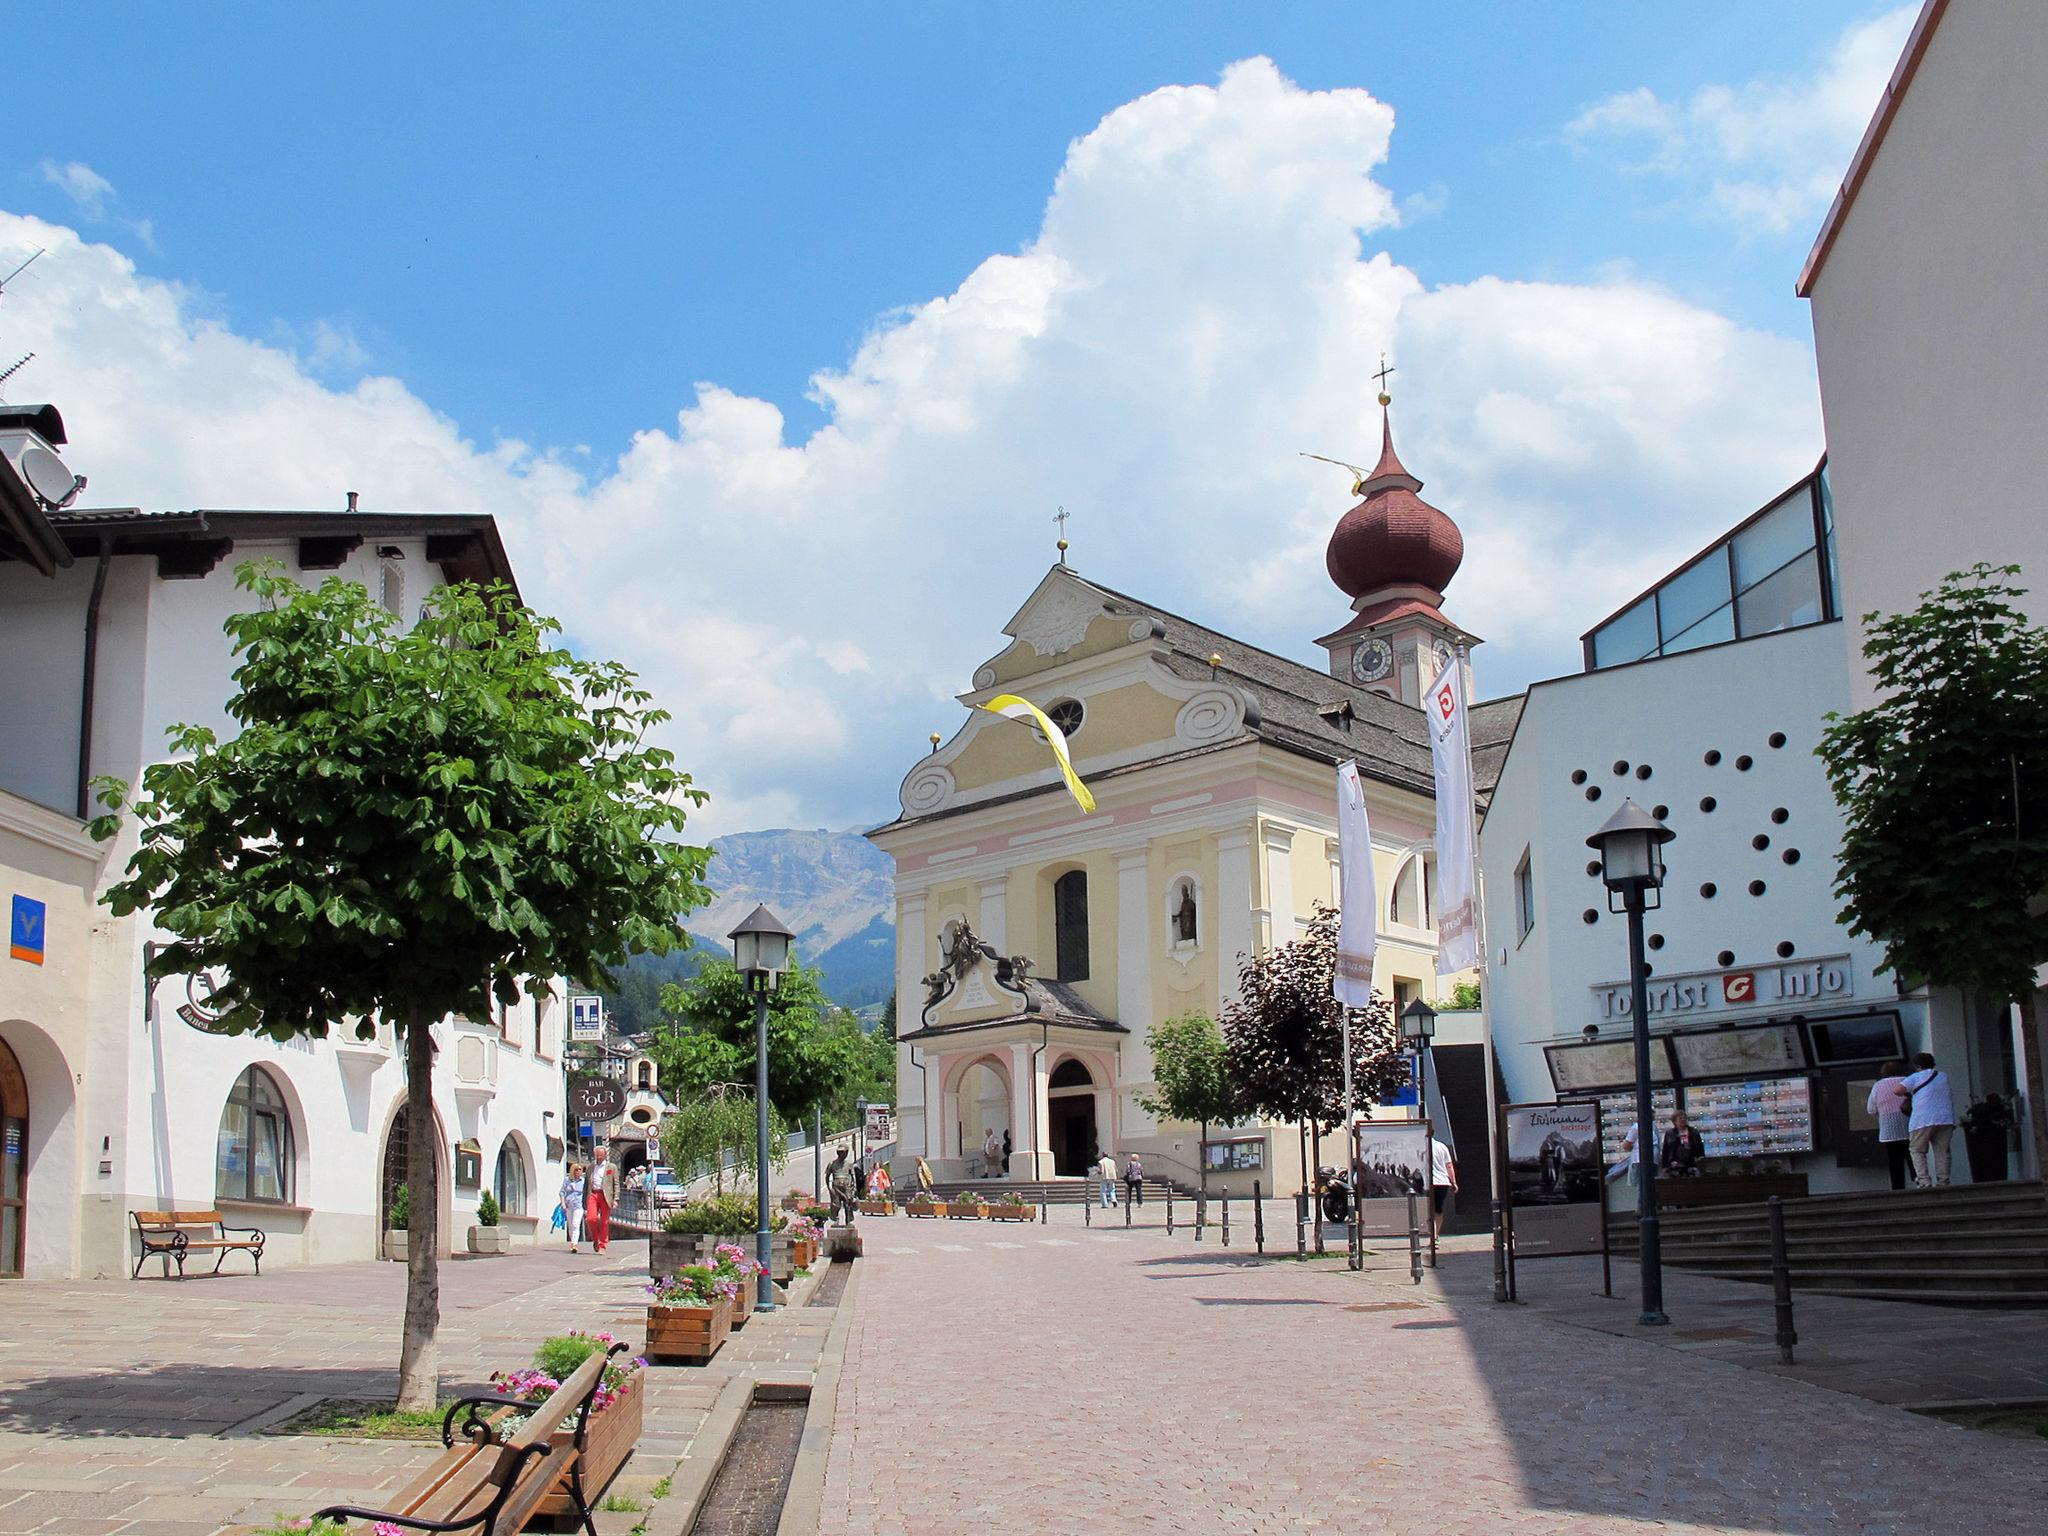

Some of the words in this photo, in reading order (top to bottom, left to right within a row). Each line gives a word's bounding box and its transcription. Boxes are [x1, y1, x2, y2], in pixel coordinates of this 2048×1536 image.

[1776, 963, 1844, 999] Info
[182, 1008, 209, 1031] Banca
[588, 1080, 604, 1088] BAR
